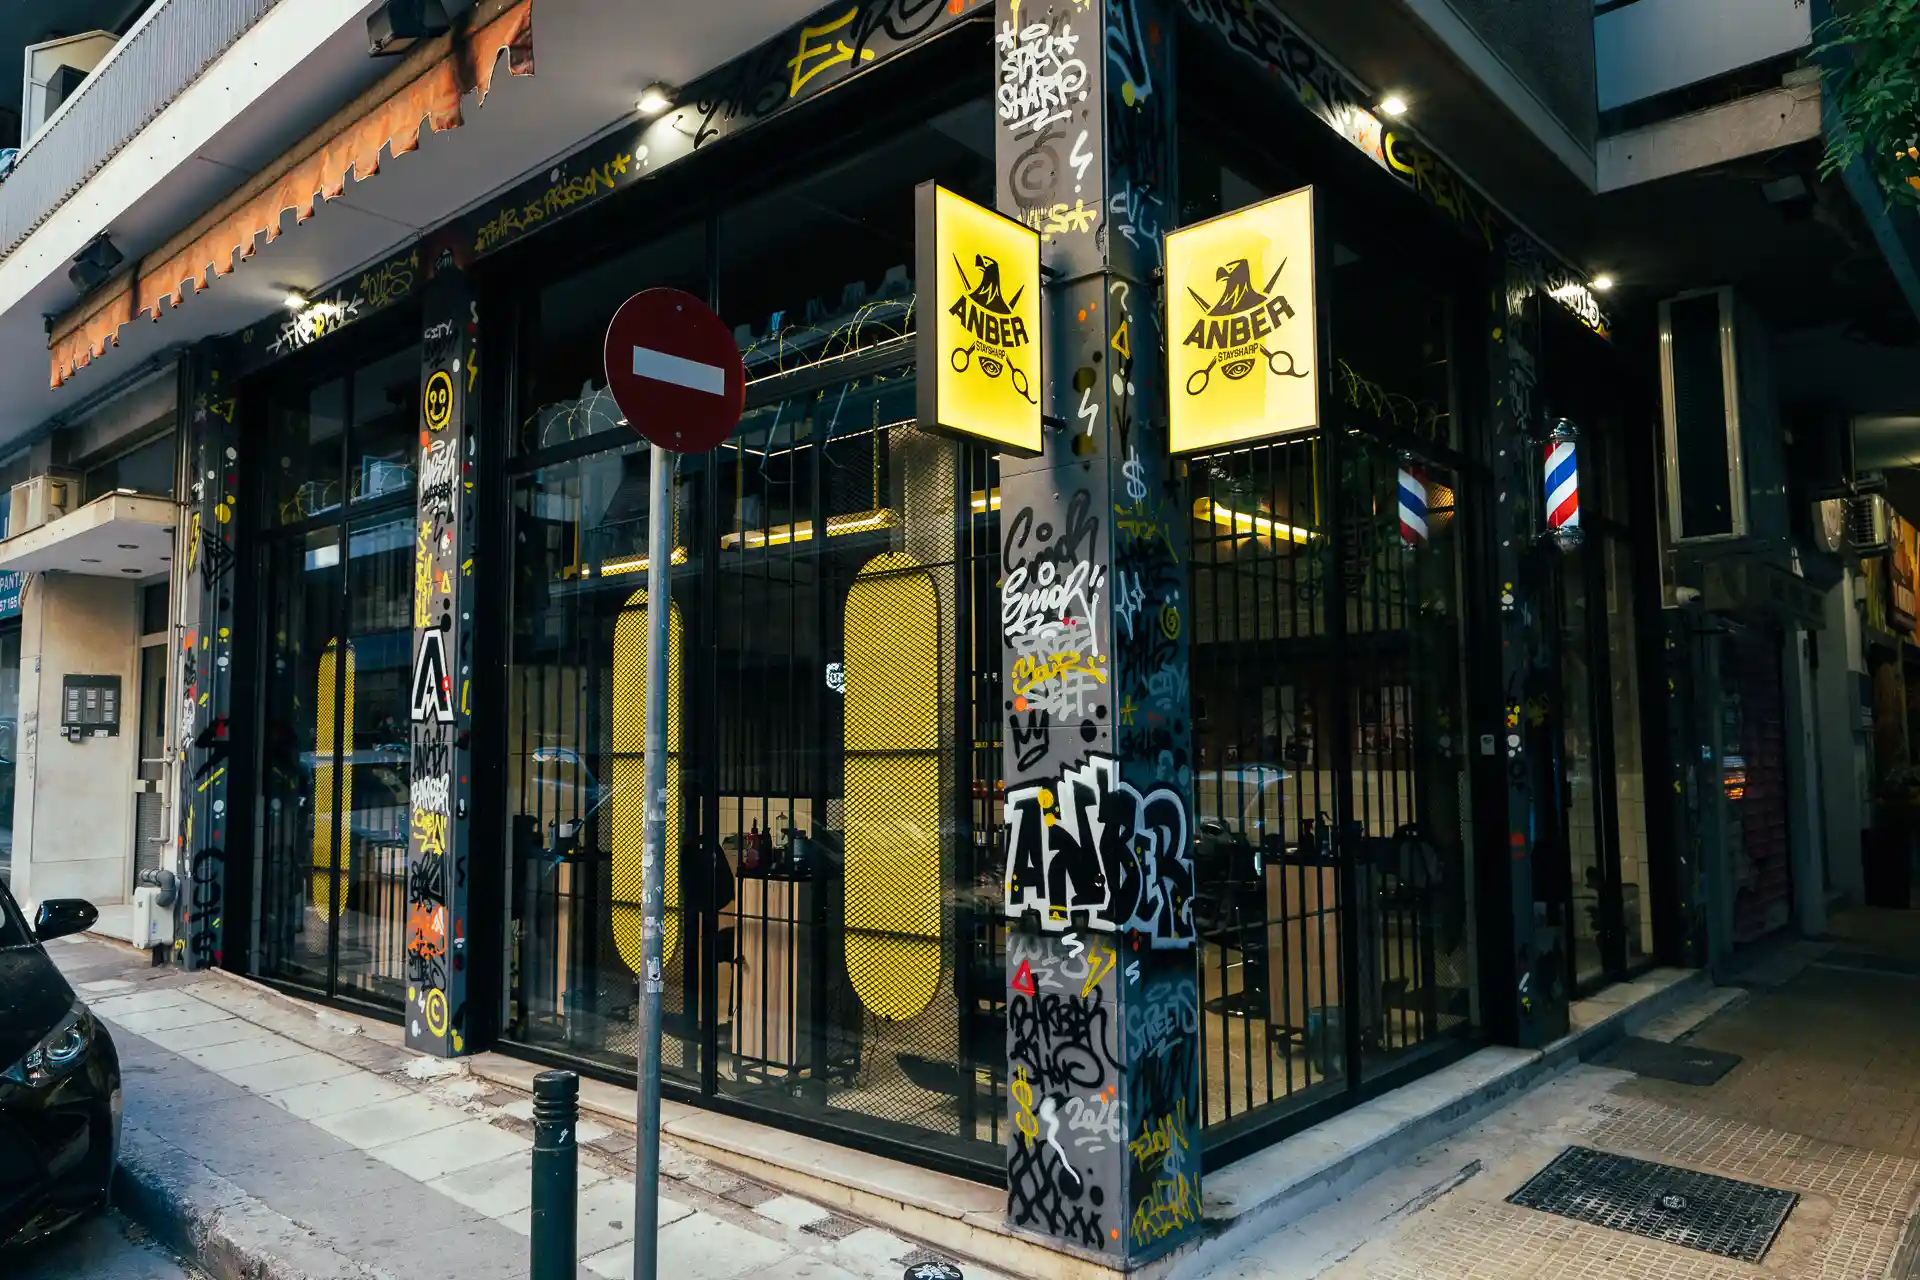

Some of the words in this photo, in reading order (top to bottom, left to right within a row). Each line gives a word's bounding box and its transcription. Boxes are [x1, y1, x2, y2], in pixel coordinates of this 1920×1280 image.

[949, 295, 1029, 348] ANBER
[1183, 296, 1295, 349] ANBER
[975, 340, 1006, 359] STAYSHARP
[1218, 343, 1259, 363] STAYSHARP
